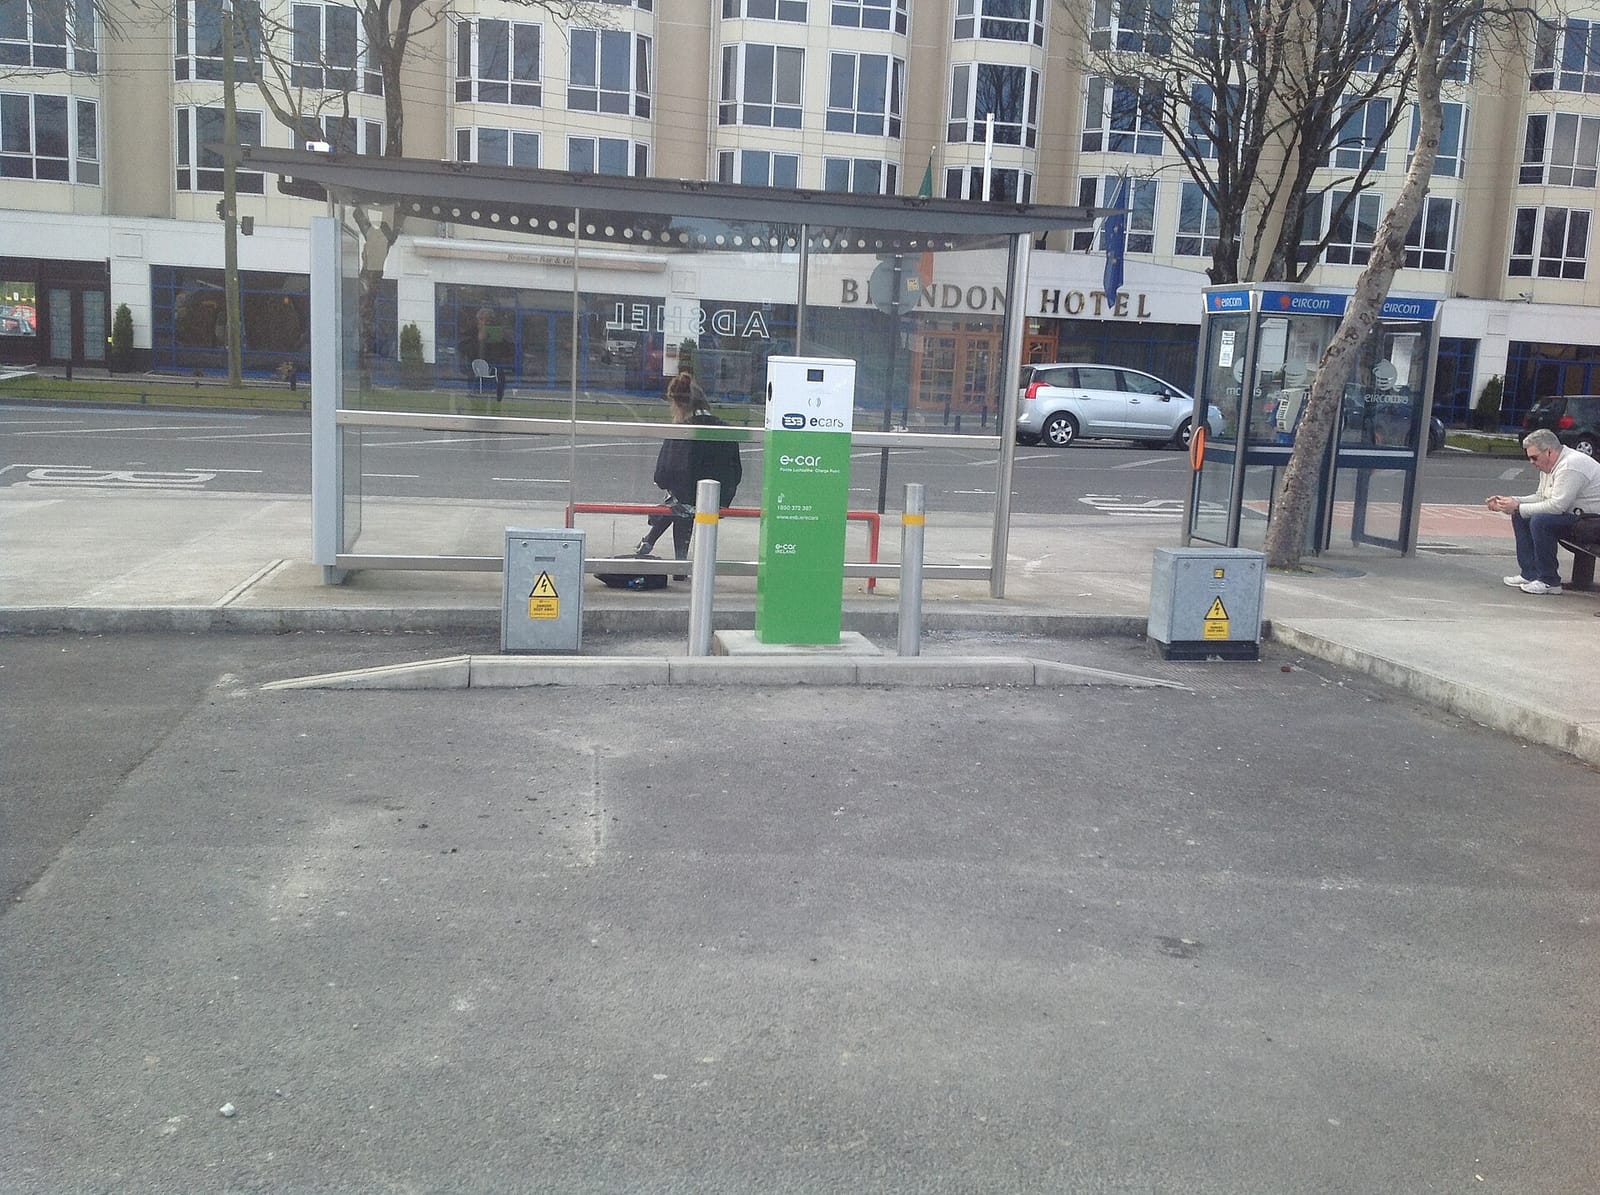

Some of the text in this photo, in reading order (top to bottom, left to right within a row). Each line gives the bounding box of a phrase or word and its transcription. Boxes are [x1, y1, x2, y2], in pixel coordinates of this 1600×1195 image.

[841, 278, 1006, 311] BNDON
[1040, 288, 1152, 318] HOTEL
[1221, 297, 1243, 307] eircom
[1291, 297, 1330, 309] eircom
[1383, 302, 1420, 315] eircom
[782, 414, 844, 428] ESB ecars
